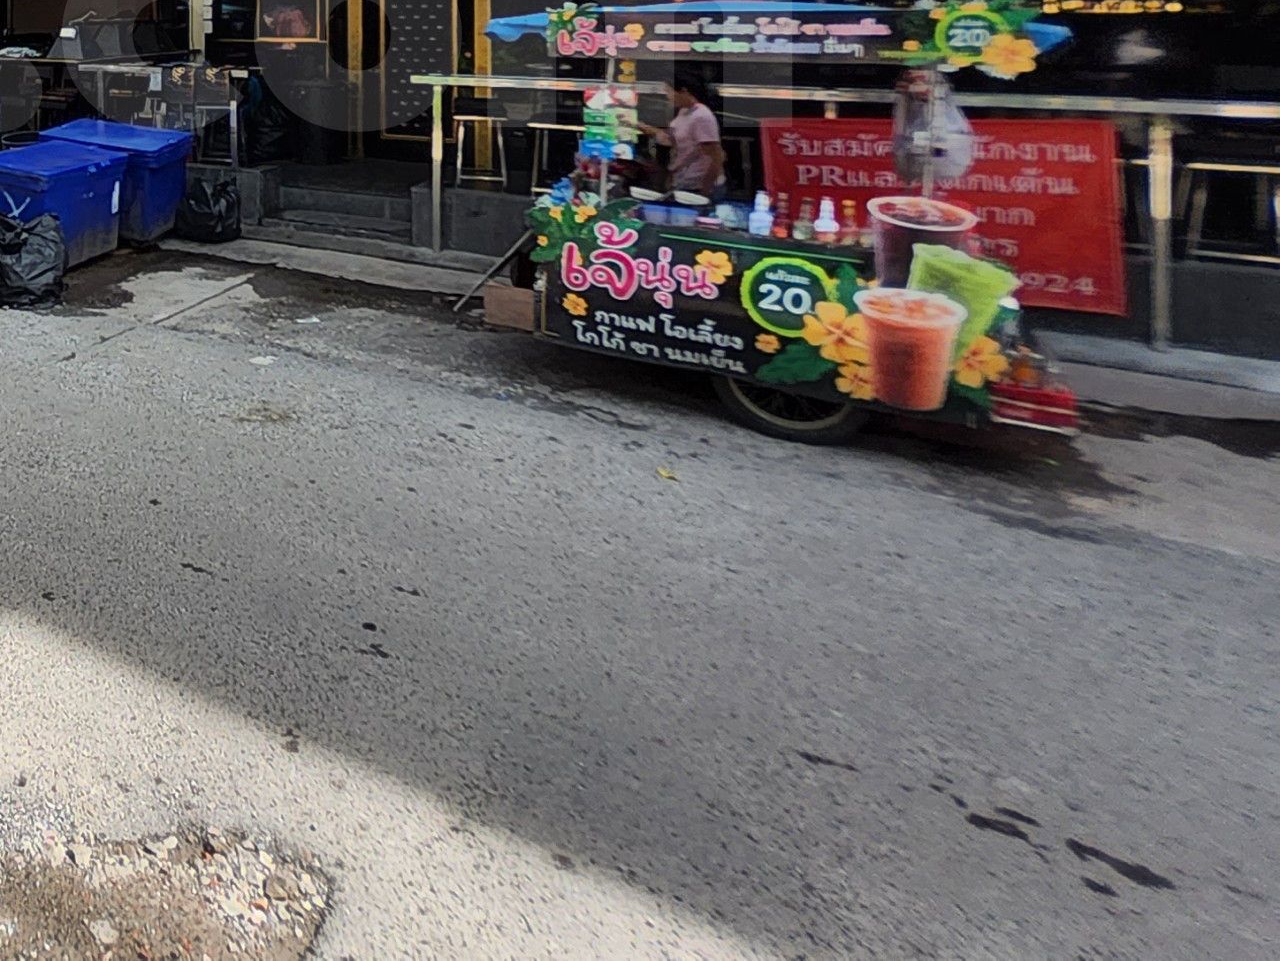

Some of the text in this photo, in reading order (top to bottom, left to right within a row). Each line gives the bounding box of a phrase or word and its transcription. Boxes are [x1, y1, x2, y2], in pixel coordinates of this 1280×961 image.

[561, 221, 718, 309] เจ้นุ่น
[572, 320, 748, 373] โกโก้ ชา นมเย็น
[594, 310, 744, 350] กาแฟ โอเลี้ยง
